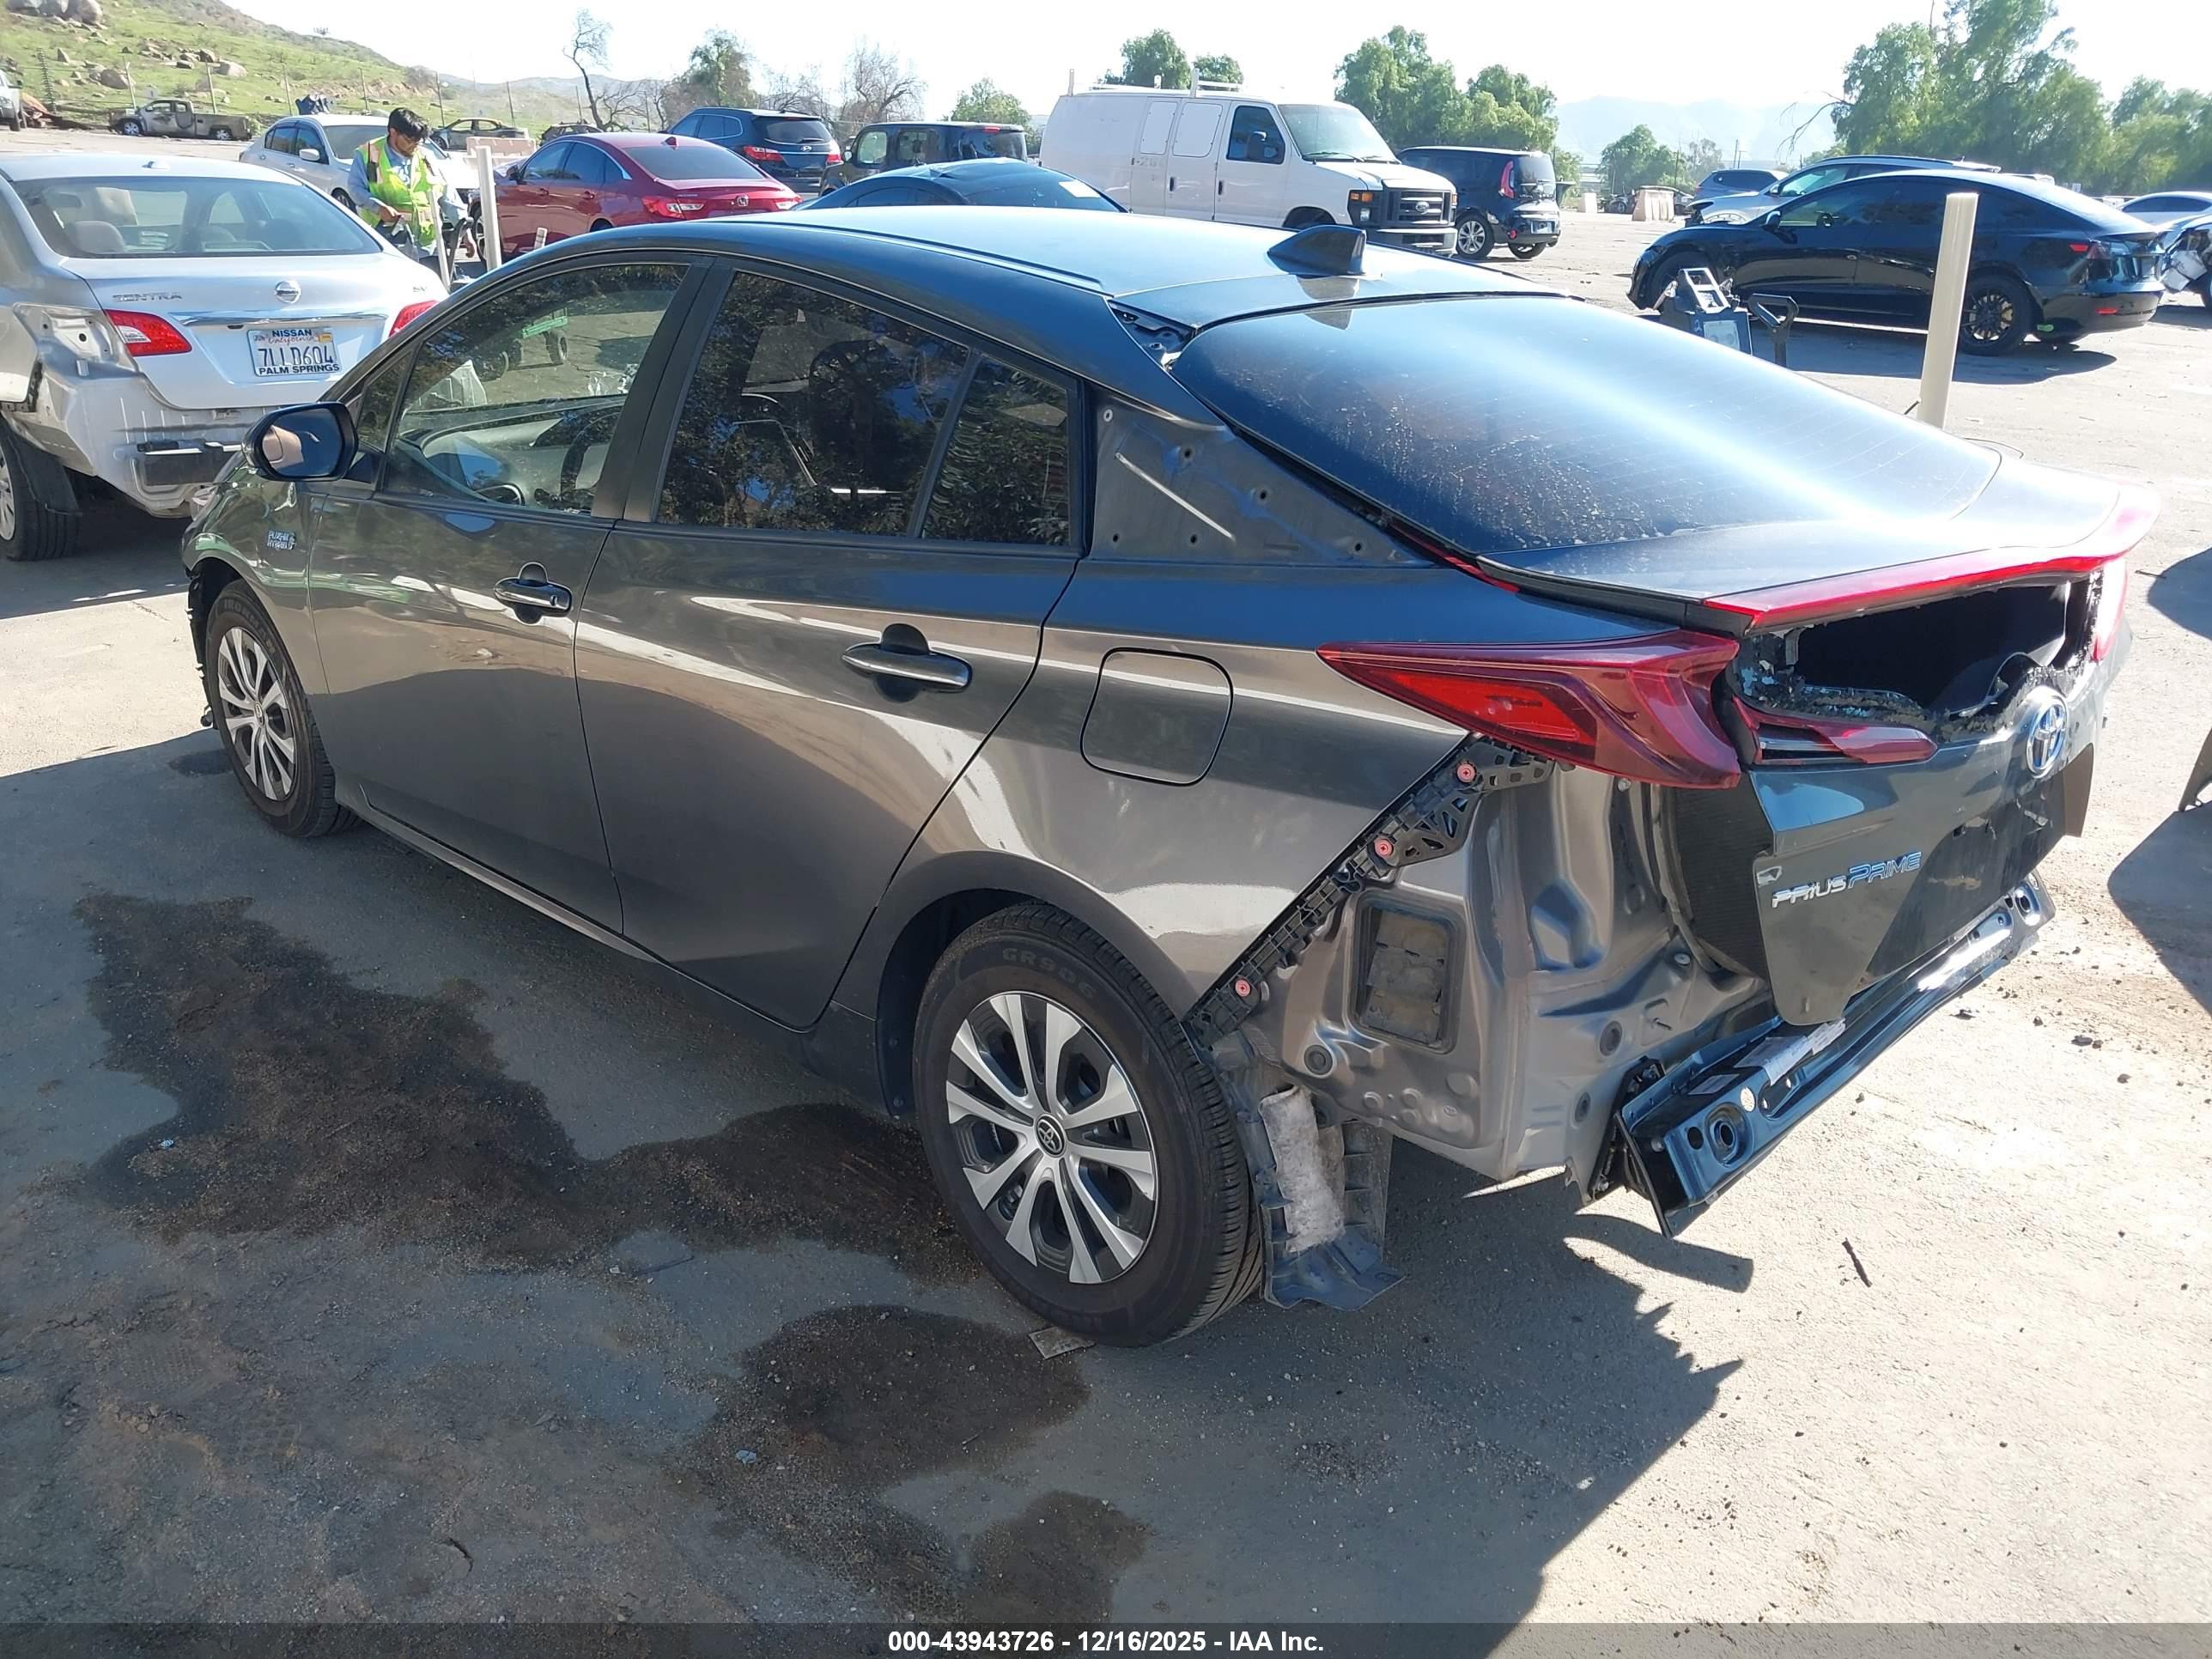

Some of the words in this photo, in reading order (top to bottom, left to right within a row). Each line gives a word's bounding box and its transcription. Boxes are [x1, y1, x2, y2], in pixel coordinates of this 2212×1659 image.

[271, 329, 313, 337] NISSAN
[258, 367, 289, 375] PALM
[293, 363, 340, 374] SPRINGS
[1771, 875, 1847, 908] PRIUS
[1847, 851, 1922, 889] PRIME
